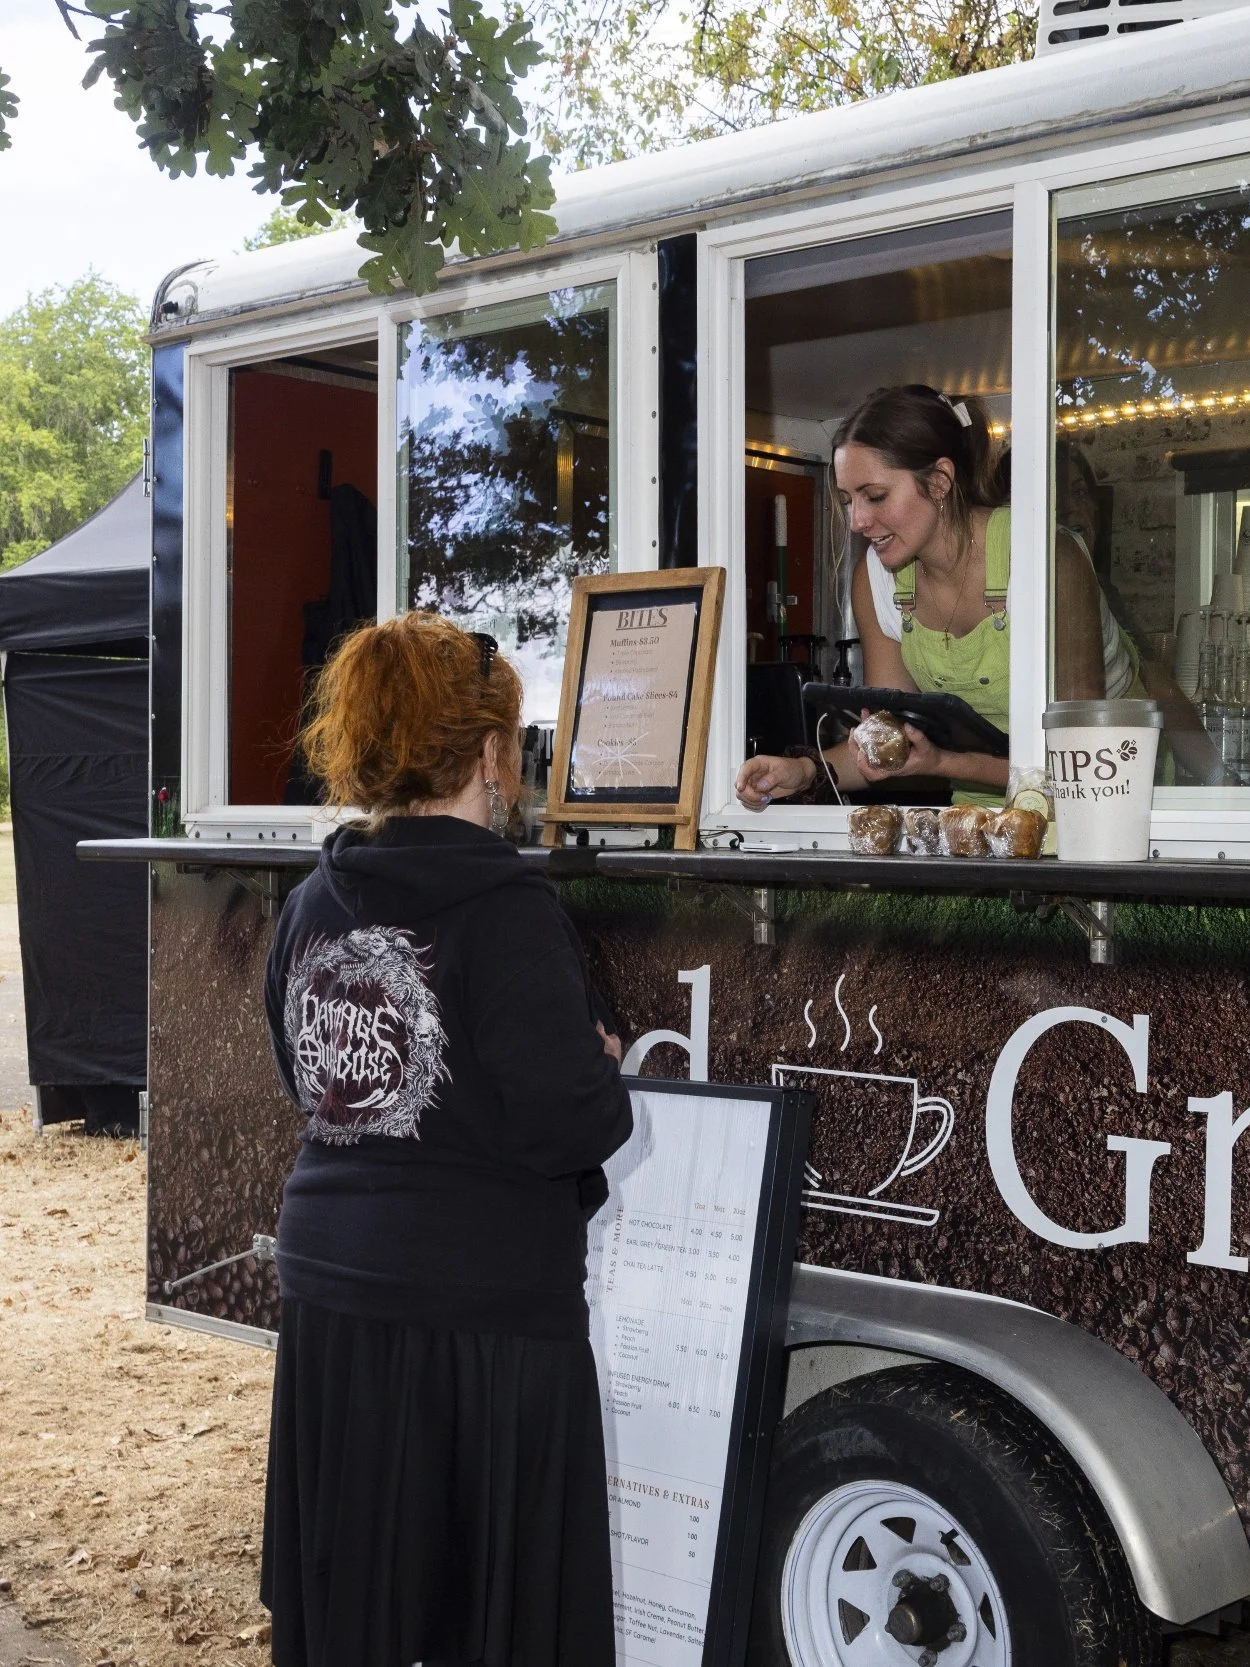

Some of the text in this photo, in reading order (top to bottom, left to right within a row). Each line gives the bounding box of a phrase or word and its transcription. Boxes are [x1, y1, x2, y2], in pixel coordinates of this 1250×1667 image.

[617, 608, 668, 629] BITES
[626, 692, 645, 701] Cake
[1048, 748, 1117, 782] TIPS
[1053, 779, 1130, 802] hank you!
[301, 984, 403, 1048] DAMAGE
[629, 1218, 640, 1229] HOT
[641, 1220, 673, 1232] CHOCOLATE
[730, 1233, 743, 1242] 5.00
[606, 1205, 624, 1293] TEAS & MORE
[626, 1238, 639, 1247] EARL
[678, 1245, 687, 1254] TEA
[623, 1259, 635, 1268] CHAI
[636, 1261, 647, 1270] TEA
[647, 1262, 664, 1273] LATTE
[616, 1314, 645, 1327] LEMONADE
[622, 1325, 649, 1337] Strawberry
[608, 1370, 671, 1389] INFUSED ENERGY DRINK
[615, 1380, 641, 1392] Strawberry
[611, 1407, 631, 1417] Coconut
[612, 1398, 630, 1407] Passion
[630, 1401, 642, 1411] Fruit
[708, 1409, 721, 1419] 7.00
[607, 1475, 710, 1511] ERNATIVES & EXTRAS
[608, 1494, 617, 1503] OR
[617, 1497, 642, 1509] ALMOND
[610, 1529, 649, 1546] SHOT/FLAVOR
[613, 1602, 633, 1613] ermint,
[634, 1607, 646, 1617] Irish
[646, 1611, 666, 1624] Creme,
[667, 1617, 686, 1629] Peanut
[622, 1592, 647, 1605] Hazelnut,
[648, 1599, 666, 1612] Honey,
[667, 1605, 696, 1621] Cinnamon,
[625, 1629, 633, 1637] SF
[633, 1631, 656, 1644] Caramel
[629, 1617, 647, 1629] Toffee
[659, 1628, 687, 1642] Lavender,
